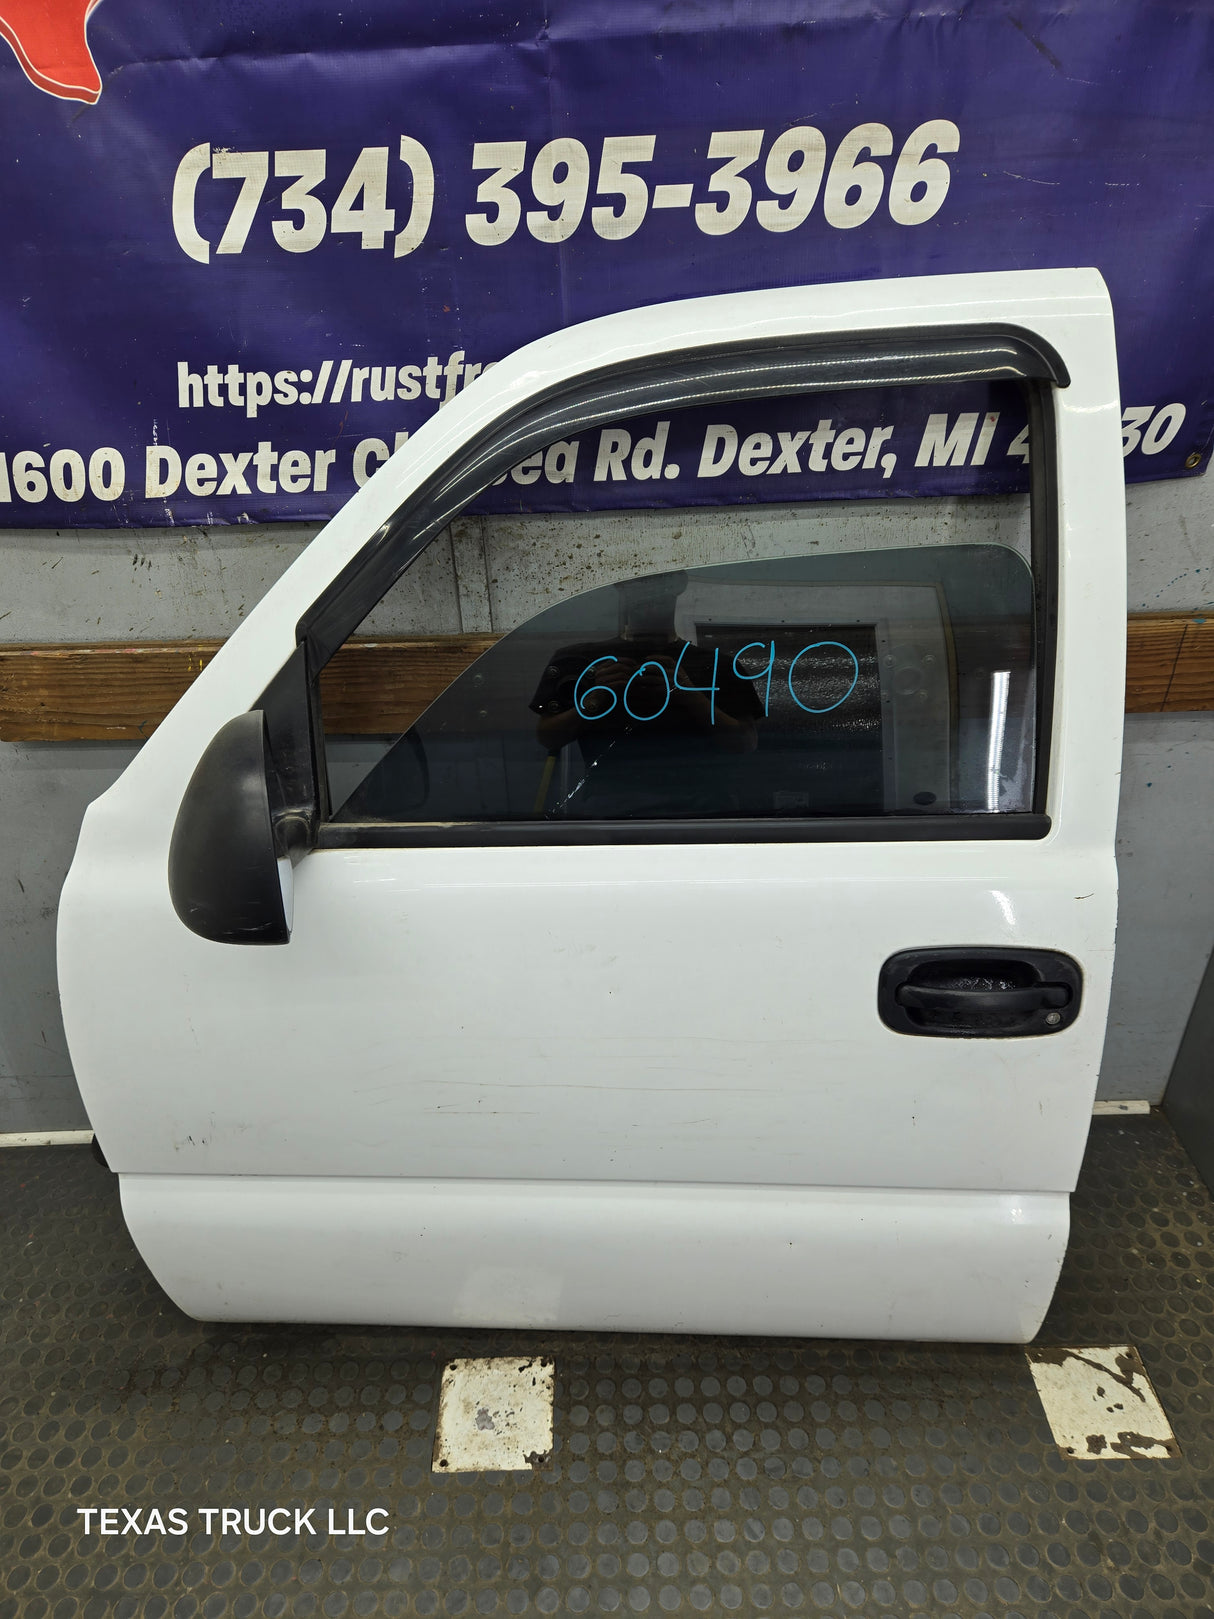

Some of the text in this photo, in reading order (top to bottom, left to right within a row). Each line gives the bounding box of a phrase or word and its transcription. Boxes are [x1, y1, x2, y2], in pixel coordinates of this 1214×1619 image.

[172, 119, 960, 265] (734) 395-3966
[177, 351, 500, 418] https://rustfr
[145, 441, 336, 499] Dexter
[593, 421, 680, 482] Rd.
[697, 422, 898, 479] Dexter,
[914, 412, 1000, 467] MI
[574, 641, 858, 725] 60490
